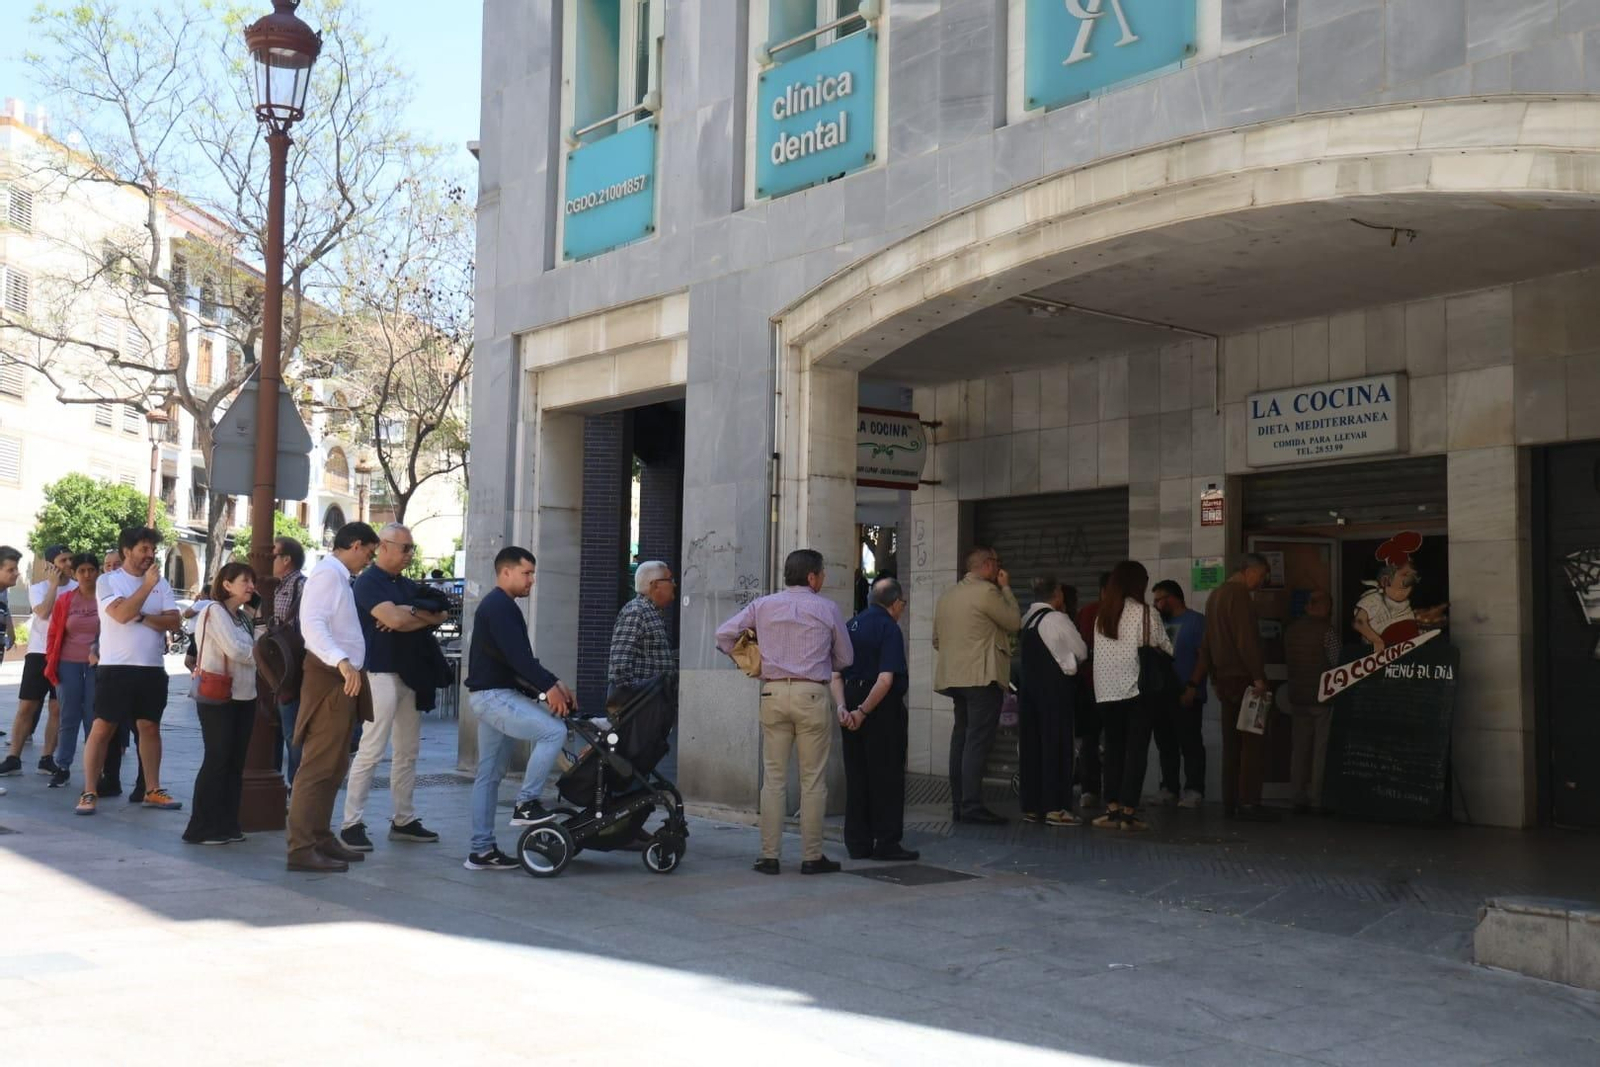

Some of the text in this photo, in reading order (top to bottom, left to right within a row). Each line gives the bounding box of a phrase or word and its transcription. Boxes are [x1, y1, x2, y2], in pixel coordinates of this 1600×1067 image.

[772, 71, 853, 120] clínica
[771, 110, 848, 165] dental
[565, 174, 646, 215] CGDO.21001857
[1251, 383, 1391, 419] LA COCINA
[857, 420, 866, 433] A
[1258, 411, 1389, 436] DIETA MEDITERRANEA
[1273, 430, 1368, 448] COMIDA PARA LLEVAR
[1323, 641, 1416, 696] LA COCINA
